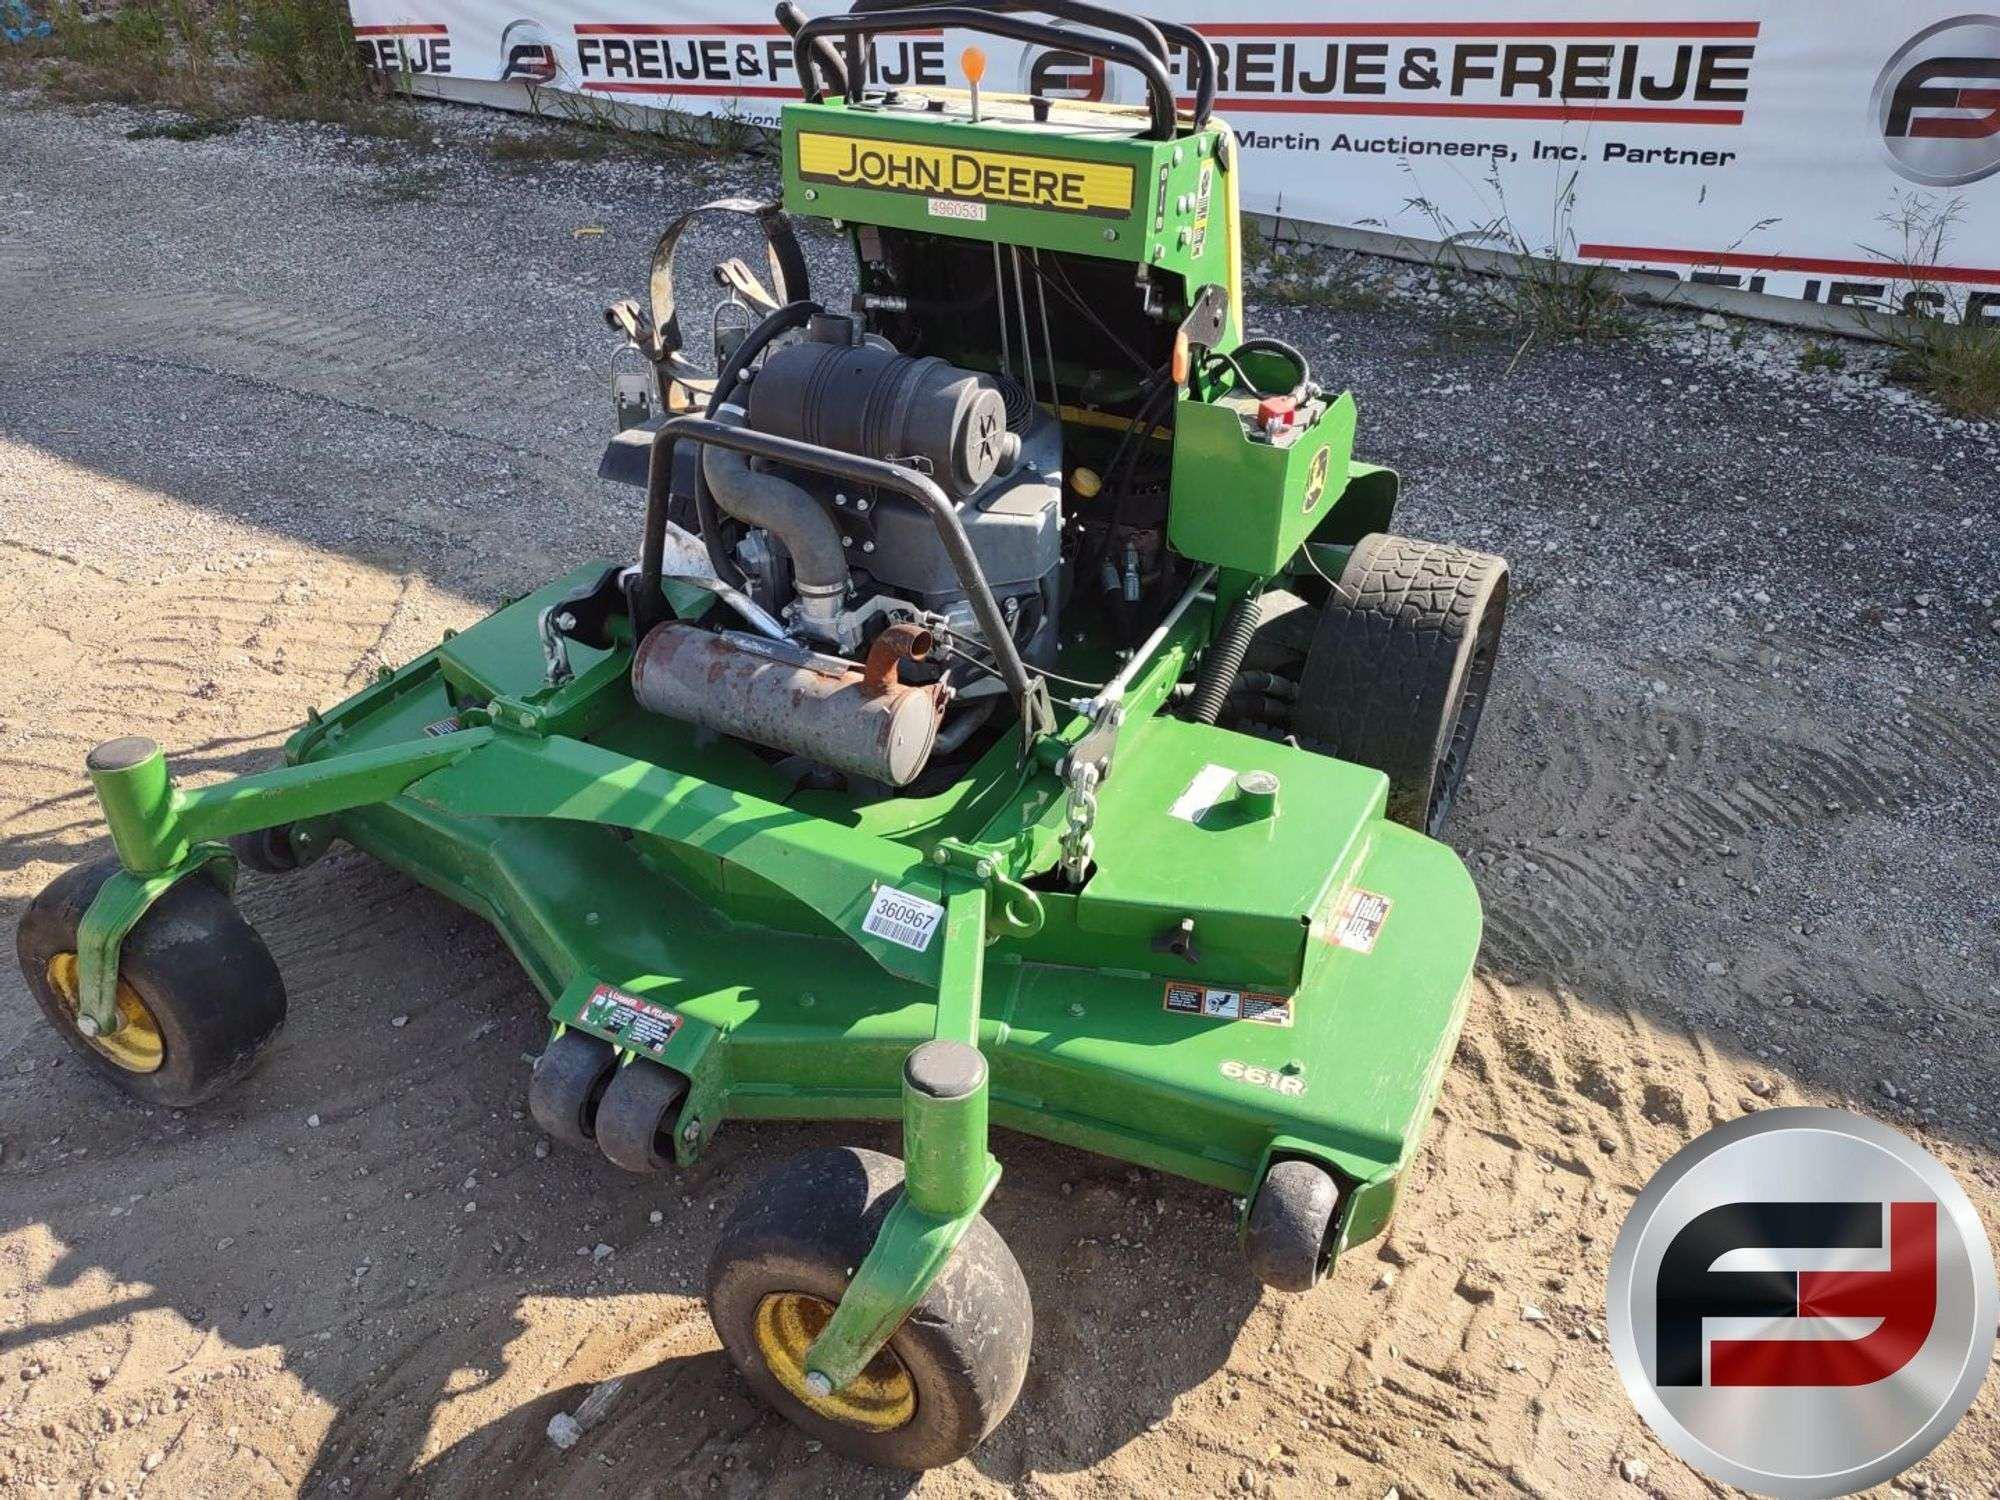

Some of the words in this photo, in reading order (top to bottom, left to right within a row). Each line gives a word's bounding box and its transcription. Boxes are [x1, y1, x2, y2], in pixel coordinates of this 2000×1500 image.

[1234, 131, 1319, 151] Martin
[1331, 134, 1517, 162] Auctioneers,
[1533, 140, 1587, 161] Inc.
[1603, 143, 1736, 167] Partner
[838, 143, 940, 187] JOHN
[952, 154, 1085, 204] DEERE
[932, 200, 985, 219] 4960531
[876, 898, 935, 931] 360967
[1219, 1060, 1306, 1097] 661R
